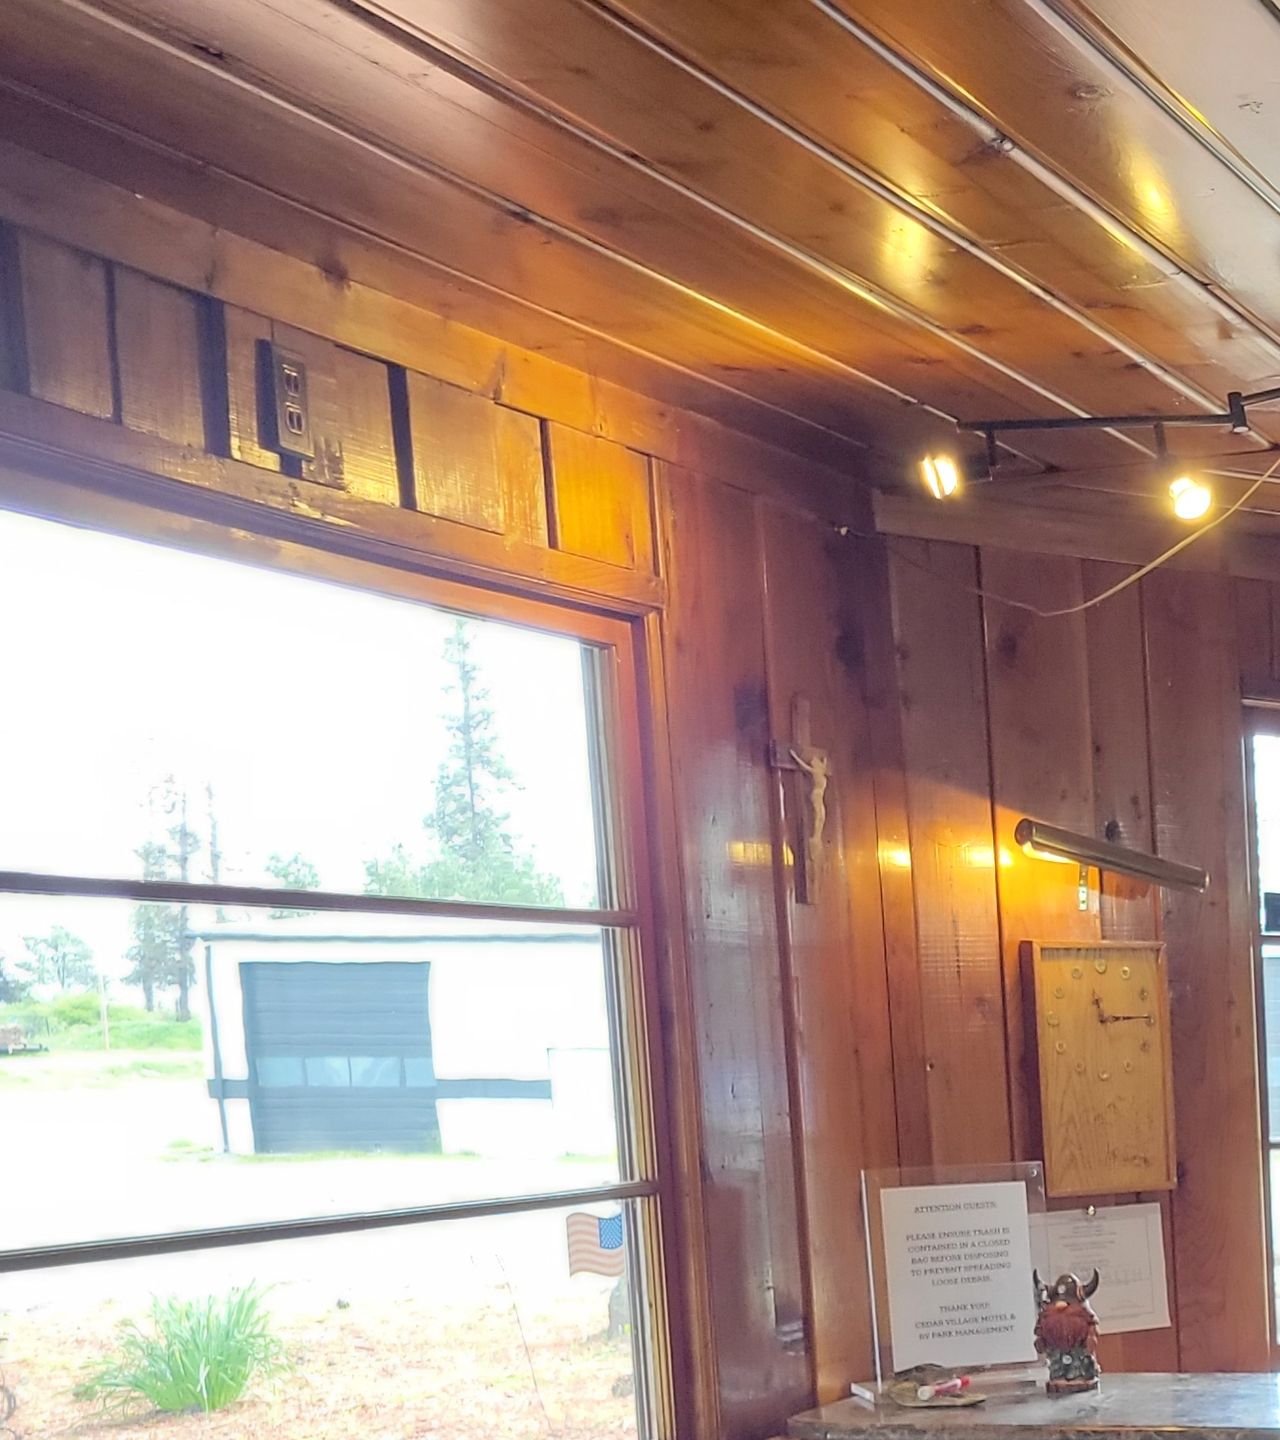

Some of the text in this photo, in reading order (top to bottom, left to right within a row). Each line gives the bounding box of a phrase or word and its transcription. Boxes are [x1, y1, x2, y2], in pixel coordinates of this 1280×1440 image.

[914, 1202, 961, 1214] ATTENTION
[906, 1226, 1010, 1241] PLEASE ENSURE TRASH IS
[907, 1239, 1010, 1253] CONTAINED IN A CLOSED
[911, 1250, 1009, 1265] BAG BEFORE DISPOSING
[910, 1262, 1012, 1277] TO PREVENT SPREADING
[931, 1277, 958, 1287] LOOSE
[939, 1303, 968, 1313] THANK
[915, 1312, 1016, 1329] CEDAR VILLAGE MOTEL &
[931, 1329, 954, 1339] PARK
[954, 1324, 1015, 1337] MANAGEMENT
